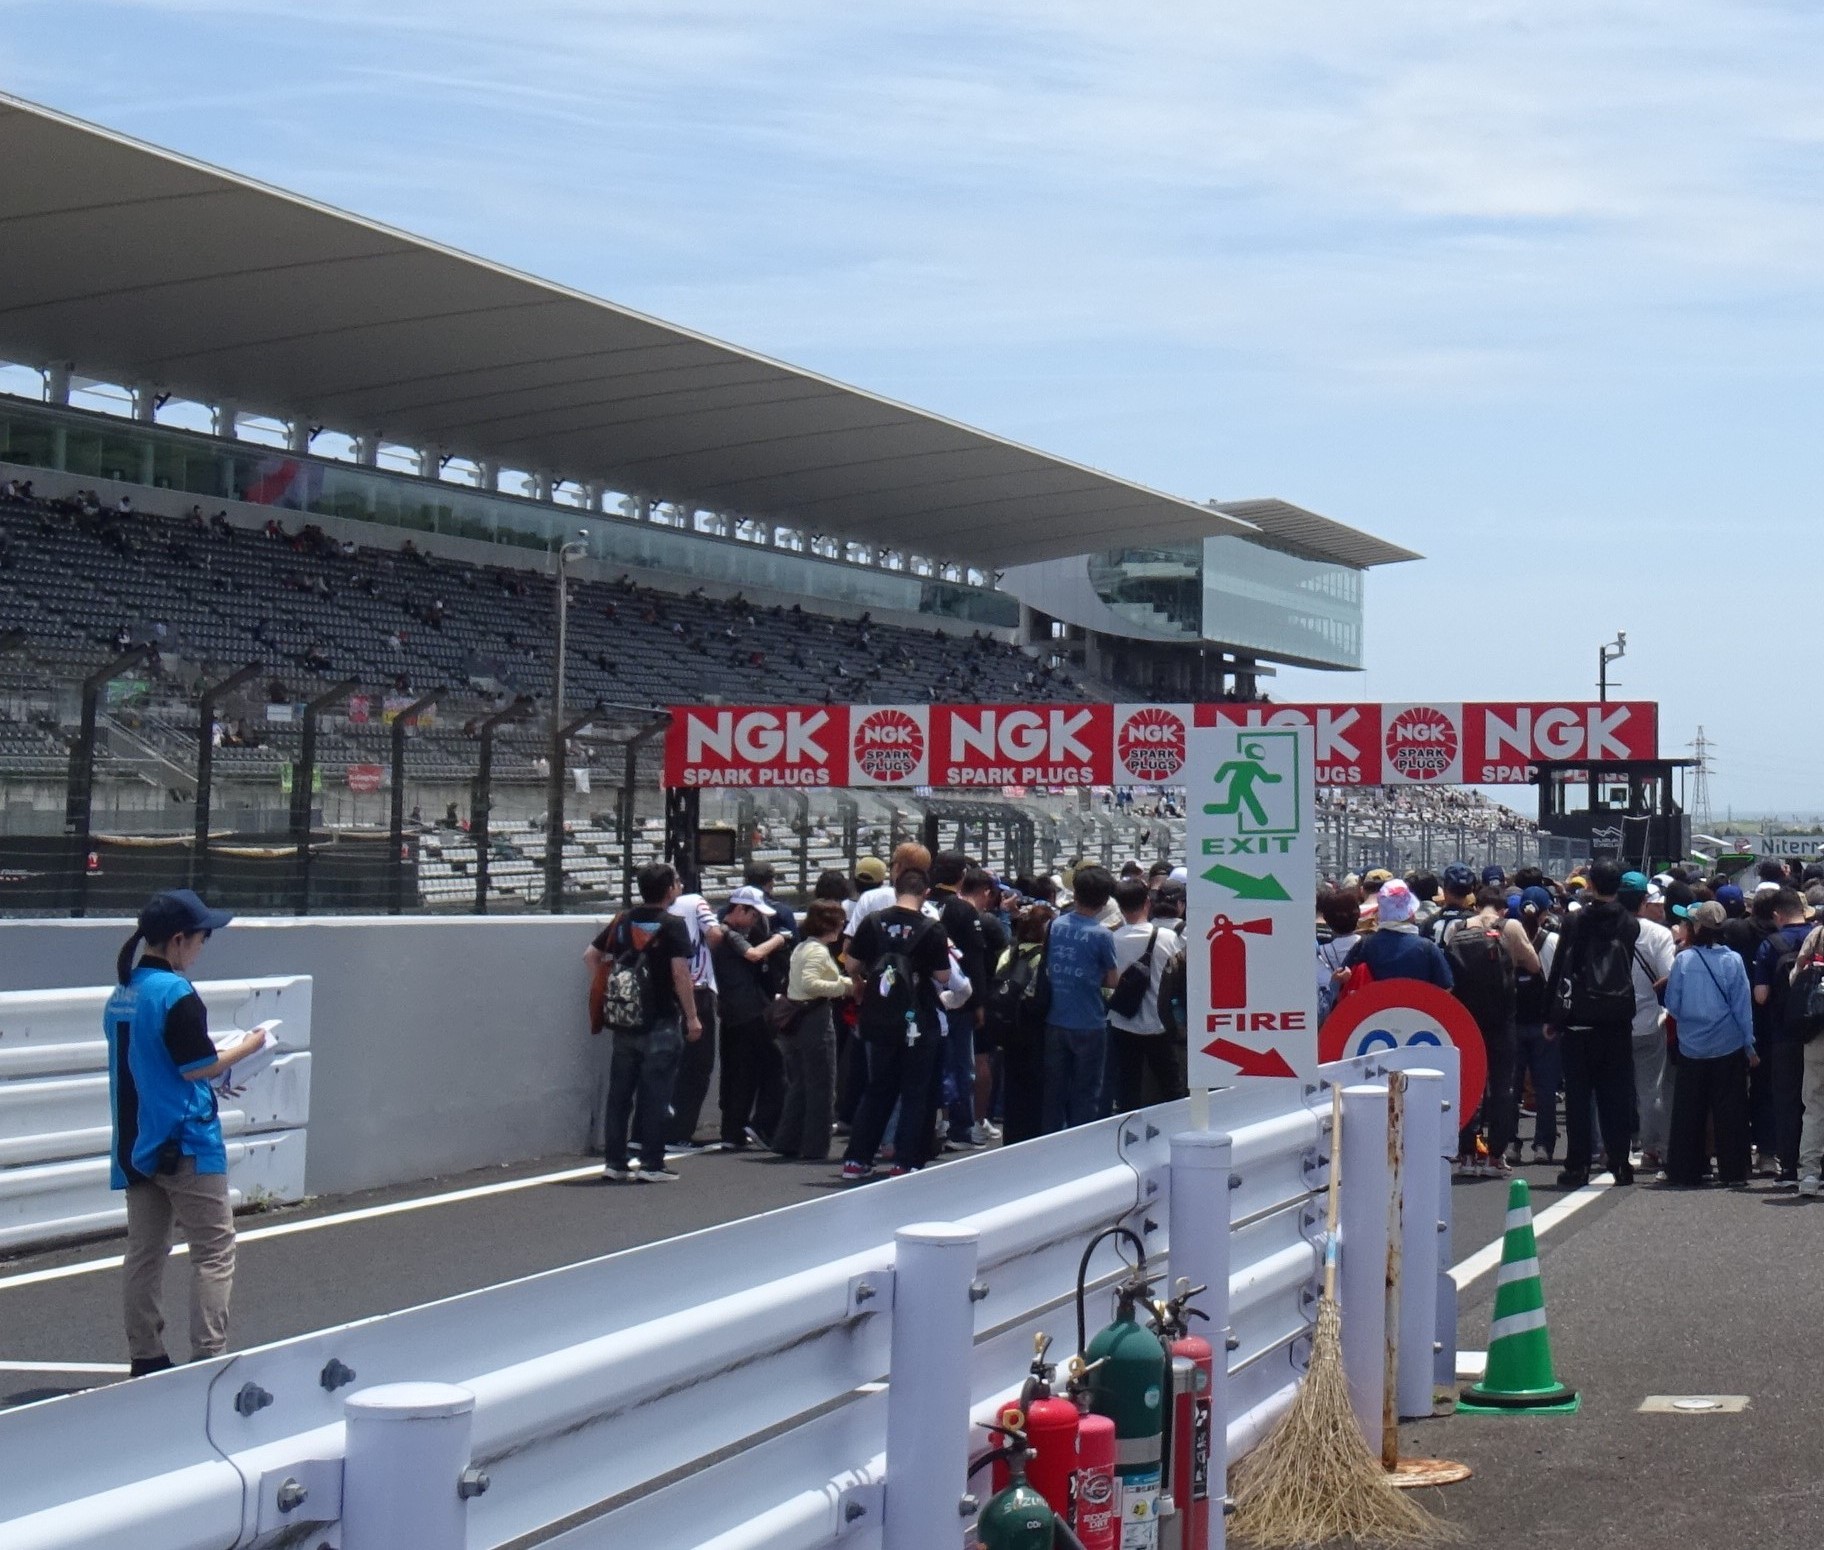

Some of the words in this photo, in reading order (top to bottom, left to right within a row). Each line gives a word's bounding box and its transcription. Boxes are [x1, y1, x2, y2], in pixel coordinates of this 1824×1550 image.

[686, 709, 831, 765] NGK
[864, 725, 913, 744] NGK
[950, 708, 1094, 764] NGK
[1128, 724, 1178, 743] NGK
[1396, 722, 1445, 742] NGK
[1485, 705, 1632, 761] NGK
[866, 750, 910, 760] SPARK
[1130, 749, 1176, 759] SPARK
[1399, 749, 1445, 758] SPARK
[866, 761, 912, 771] PLUGS
[1130, 760, 1176, 770] PLUGS
[1399, 759, 1445, 769] PLUGS
[683, 768, 752, 785] SPARK
[759, 768, 830, 785] PLUGS
[947, 767, 1017, 784] SPARK
[1022, 766, 1094, 784] PLUGS
[1315, 766, 1361, 783] UGS
[1481, 765, 1539, 782] SPAR
[1201, 836, 1297, 855] EXIT
[1206, 1011, 1306, 1033] FIRE
